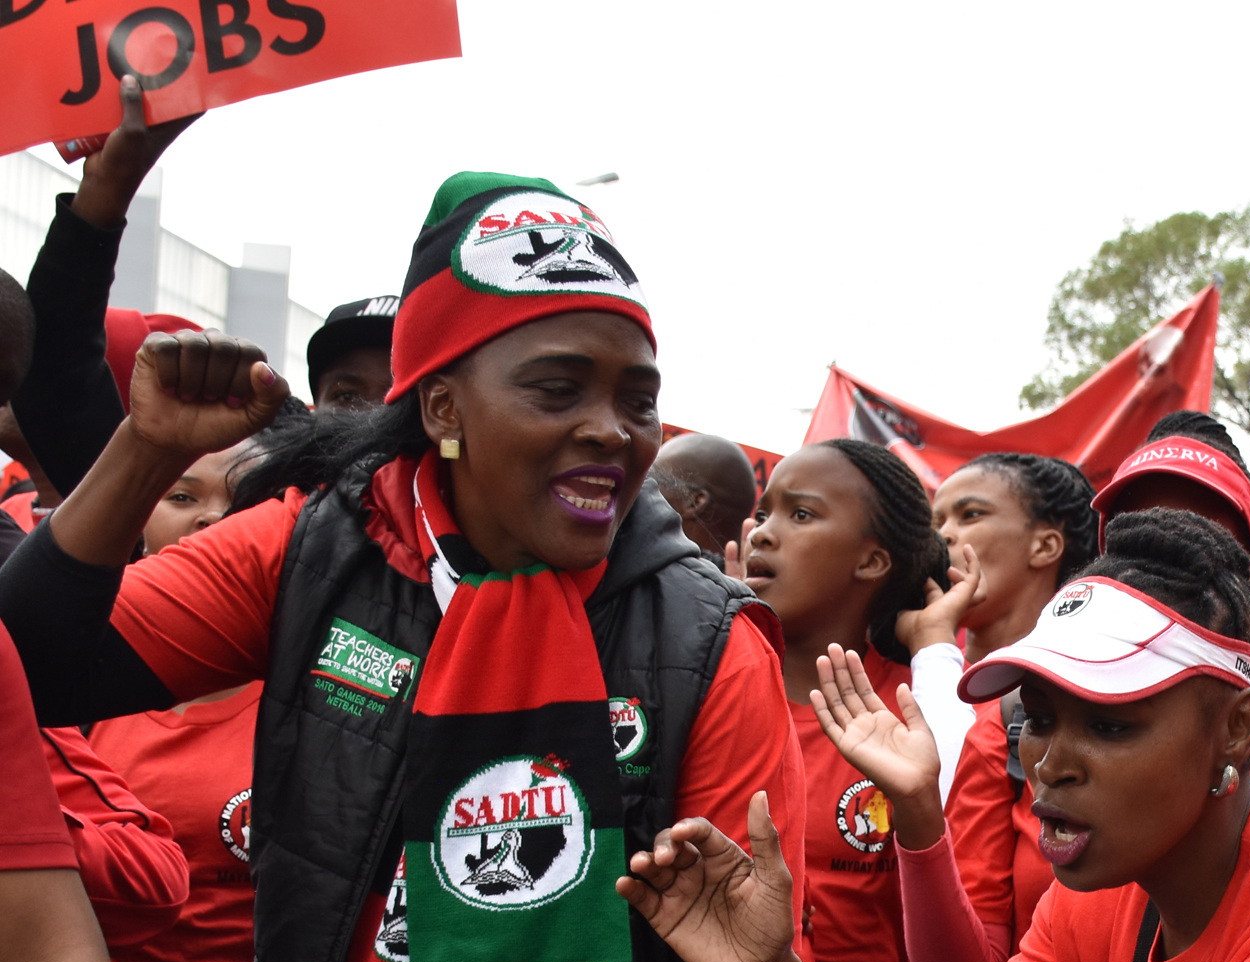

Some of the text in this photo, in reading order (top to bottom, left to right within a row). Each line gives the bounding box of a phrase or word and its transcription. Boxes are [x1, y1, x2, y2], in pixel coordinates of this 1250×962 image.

[59, 0, 326, 106] JOBS
[321, 642, 347, 660] AT
[347, 651, 391, 680] WORK
[331, 626, 395, 667] TEACHERS
[314, 678, 335, 693] SATO
[336, 687, 367, 706] GAMES
[326, 694, 363, 717] NETBALL
[625, 763, 651, 777] Cape
[454, 785, 567, 829] SADTU
[221, 828, 234, 844] OF
[837, 816, 849, 832] OF
[843, 832, 867, 852] MINE
